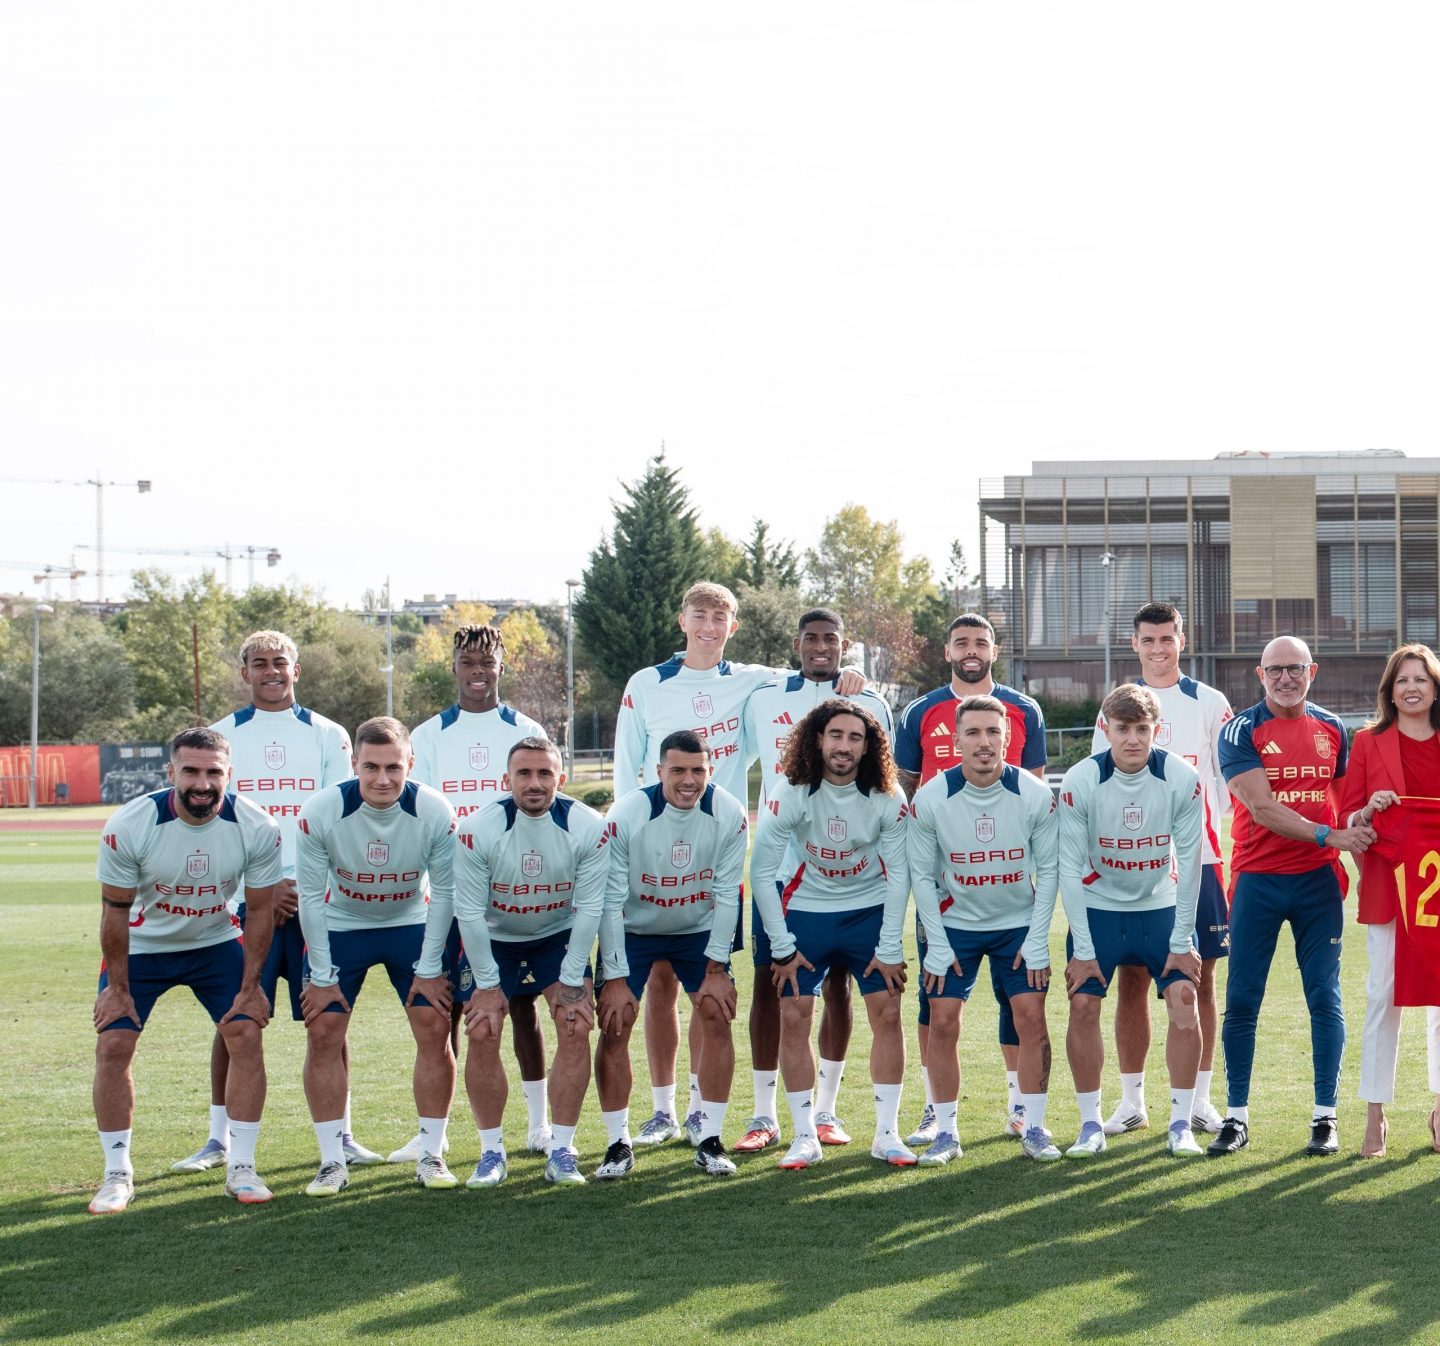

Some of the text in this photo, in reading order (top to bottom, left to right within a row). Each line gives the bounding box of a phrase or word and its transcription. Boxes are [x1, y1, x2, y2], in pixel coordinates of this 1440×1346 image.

[690, 717, 739, 738] BRO
[711, 741, 738, 759] FRE
[1265, 766, 1331, 780] EBRO
[237, 778, 315, 791] EBRO
[261, 805, 302, 816] PFR
[1099, 834, 1171, 850] EBRO
[806, 841, 858, 860] EBR
[950, 848, 1024, 863] EBRO
[1101, 854, 1170, 871] MAPFRE
[337, 868, 419, 884] EBRO
[641, 868, 713, 887] EBRO
[953, 869, 1024, 887] MAPFRE
[338, 884, 418, 903] MAPFRE
[492, 882, 572, 896] EBRO
[492, 900, 571, 915] MAPFRE
[640, 891, 711, 908] MAPFRE
